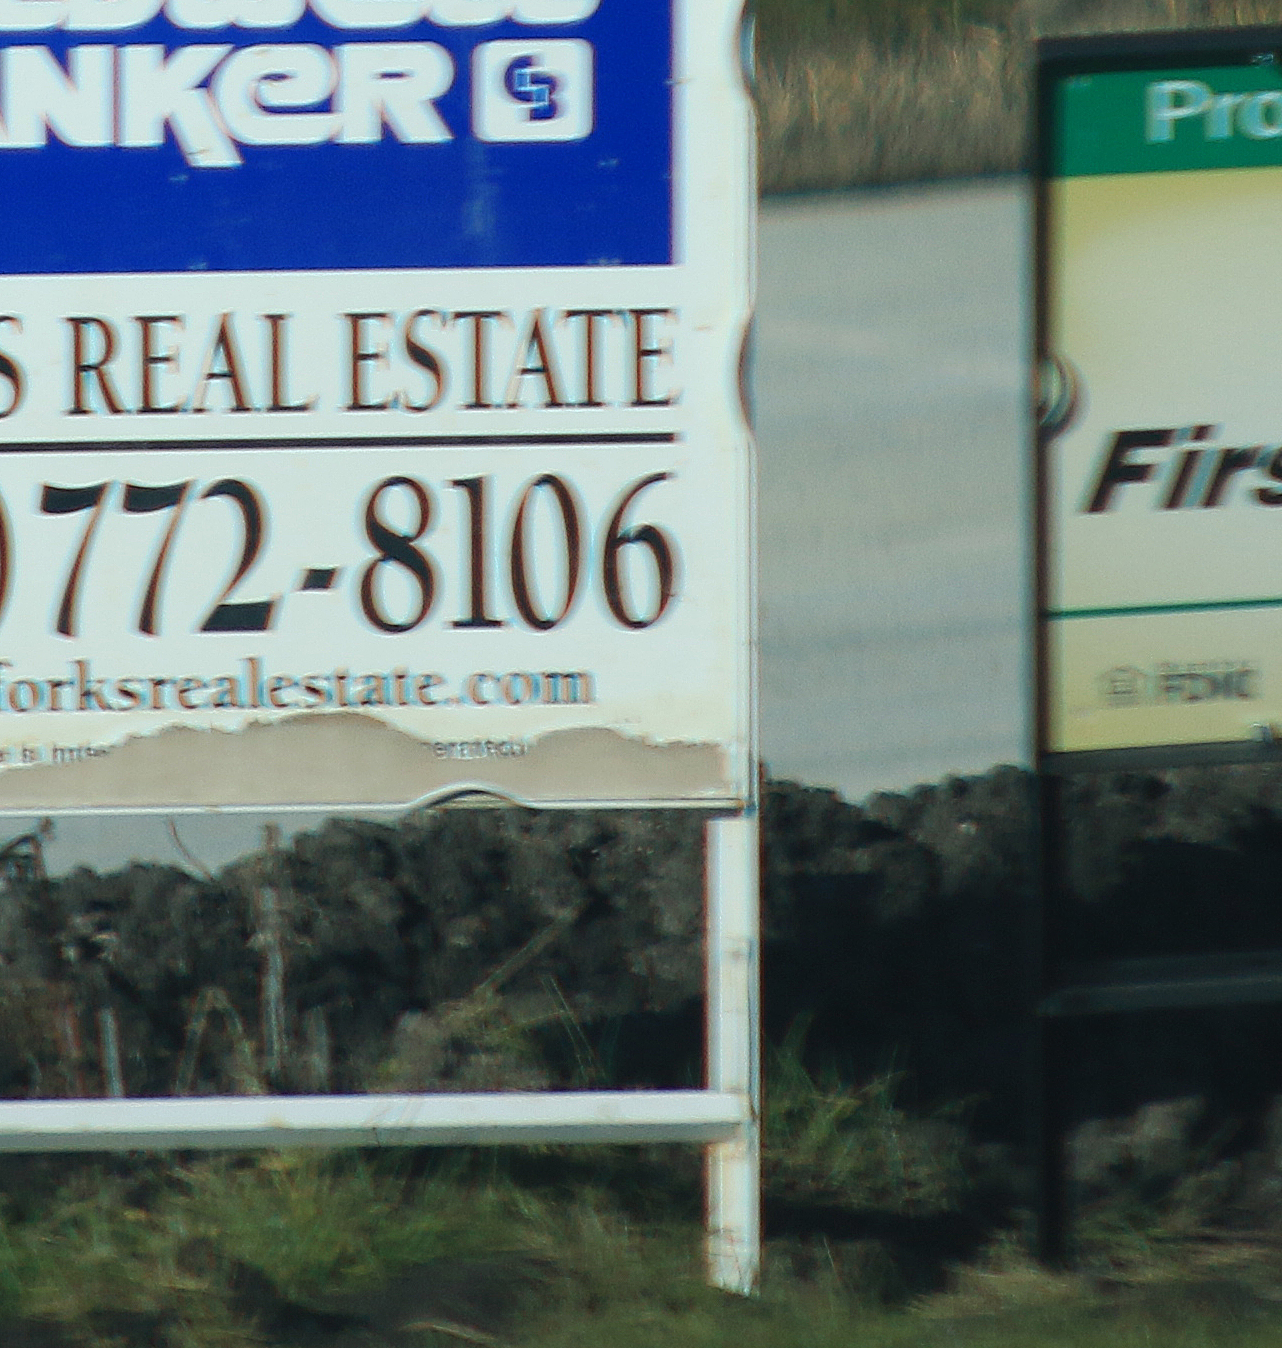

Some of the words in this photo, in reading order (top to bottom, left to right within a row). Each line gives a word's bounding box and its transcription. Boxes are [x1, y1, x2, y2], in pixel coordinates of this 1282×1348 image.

[65, 313, 318, 418] REAL
[342, 307, 676, 415] ESTATE
[38, 470, 678, 638] 772-8106
